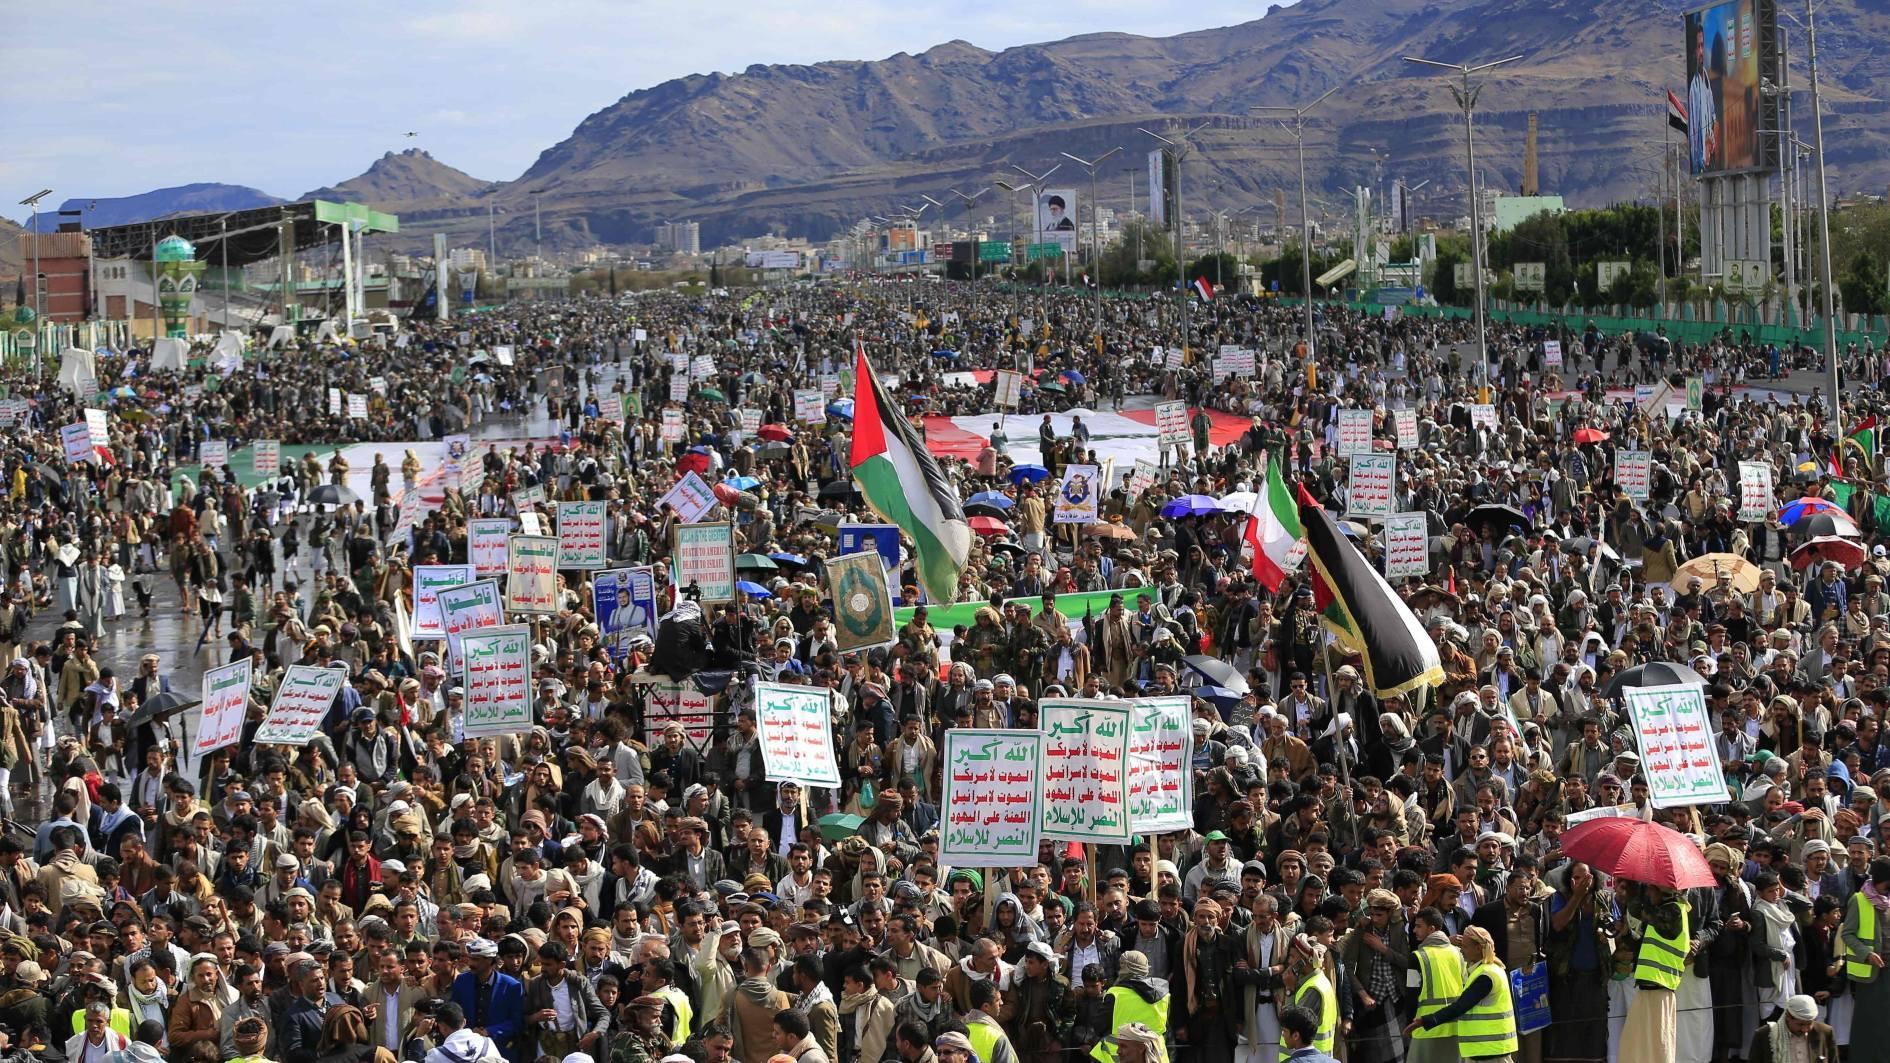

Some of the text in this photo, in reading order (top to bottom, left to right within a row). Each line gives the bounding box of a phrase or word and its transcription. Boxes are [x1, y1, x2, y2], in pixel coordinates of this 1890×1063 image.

[515, 544, 555, 558] قاطعوا
[682, 546, 728, 557] DEATH TO AMERICA
[683, 559, 724, 569] DEATH TO ISRAEL
[708, 586, 713, 596] TO
[715, 585, 730, 595] ISLAM
[443, 587, 492, 615] قاطعوا
[469, 638, 524, 660] الله أكبر
[209, 665, 246, 696] قاطعوا
[287, 671, 338, 688] الله أكبر
[469, 703, 527, 721] النصر للإسلام
[764, 695, 824, 715] الله أكبر
[1639, 695, 1699, 721] الله أكبر
[1048, 711, 1123, 740] الله أكبر
[1161, 712, 1185, 732] الله
[954, 738, 1034, 766] الله أكبر
[1047, 740, 1120, 760] الموت لأمريكا
[953, 766, 1033, 784] الموت لأمريكا
[1046, 764, 1120, 782] الموت لإسرائيل
[1655, 771, 1717, 794] النصر للإسلام
[952, 789, 1031, 805] الموت لإسرائيل
[1045, 786, 1121, 803] اللعنة على اليهود
[950, 810, 1030, 825] اللعنة على اليهود
[1045, 806, 1122, 830] النصر للإسلام
[949, 828, 1029, 850] النصر للإسلام
